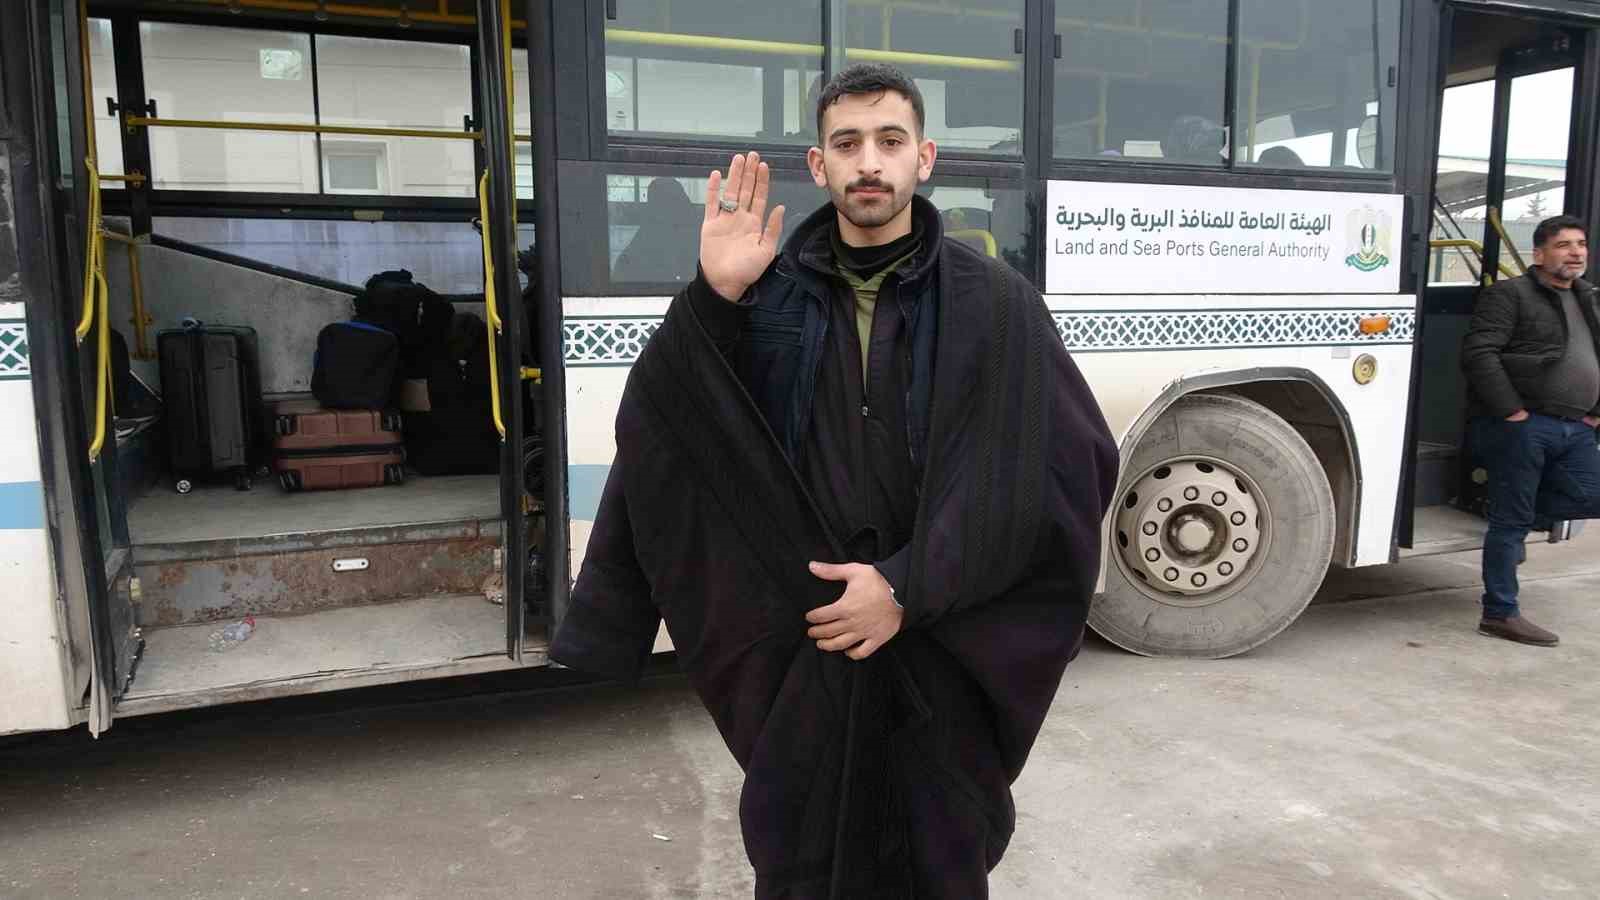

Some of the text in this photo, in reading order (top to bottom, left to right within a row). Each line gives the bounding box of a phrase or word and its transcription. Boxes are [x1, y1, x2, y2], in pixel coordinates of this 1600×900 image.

[1055, 205, 1333, 236] الهيئة العامة للمنافذ البرية والبحرية
[1055, 237, 1330, 263] Land and Sea Ports General Authority
